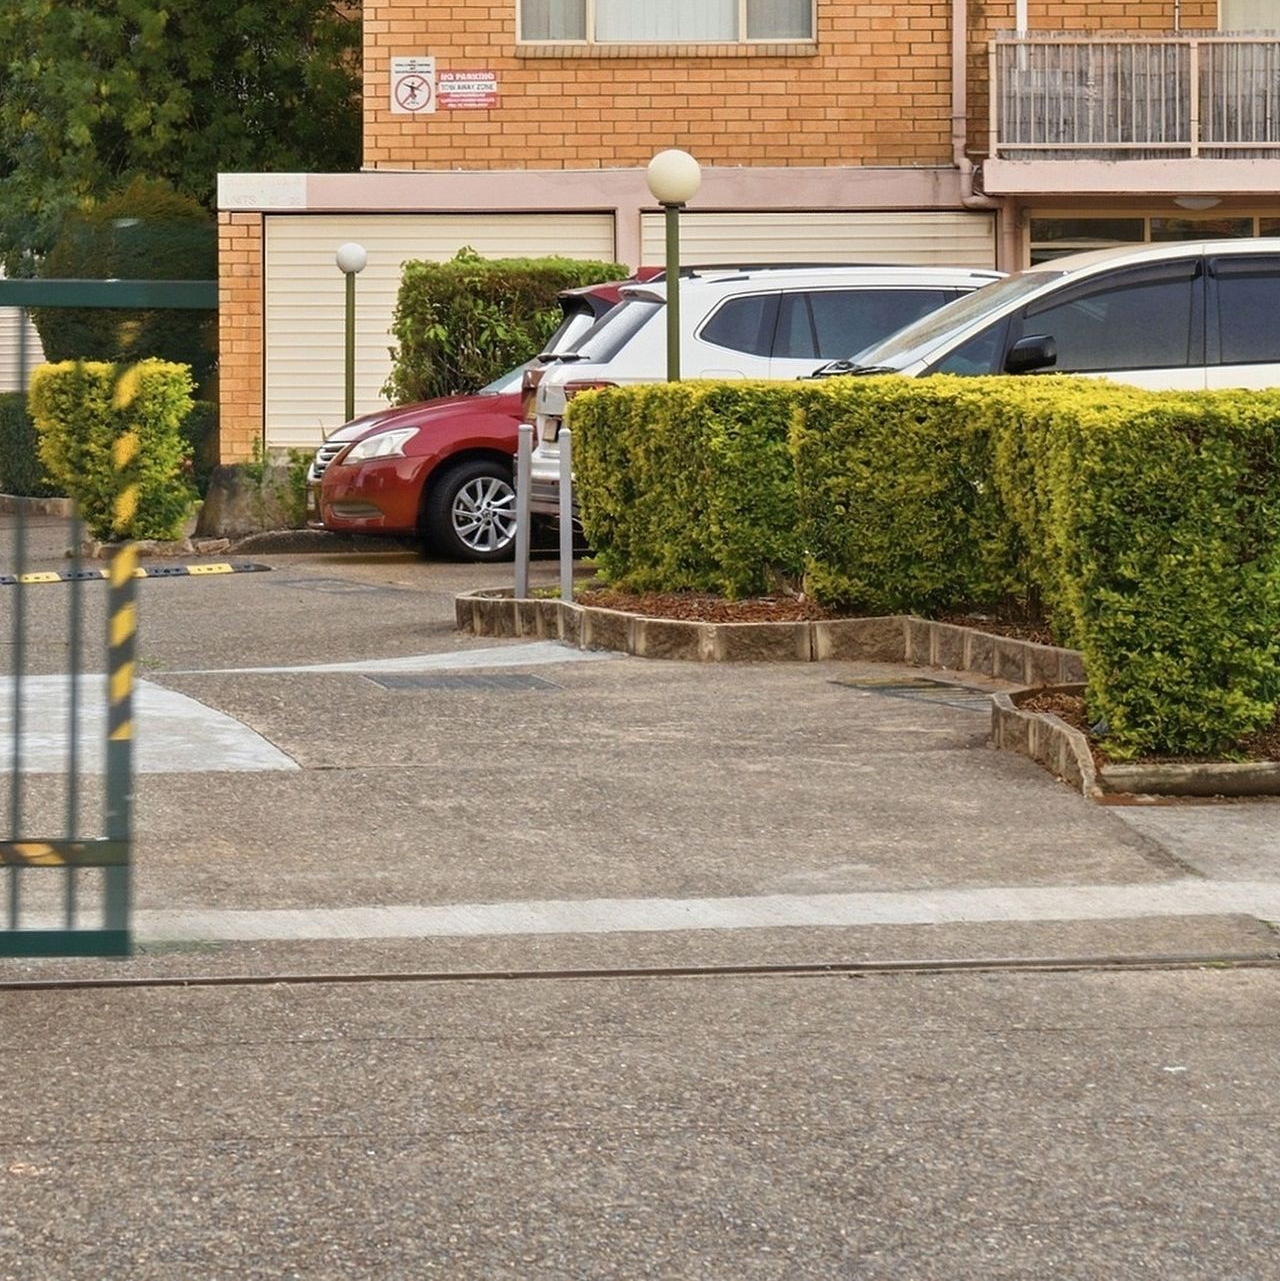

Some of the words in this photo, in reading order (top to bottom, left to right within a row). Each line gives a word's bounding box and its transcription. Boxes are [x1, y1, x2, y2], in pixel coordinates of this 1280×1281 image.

[440, 73, 454, 81] NO
[455, 73, 495, 81] PARKING
[441, 83, 456, 91] TOW
[457, 83, 475, 91] AWAY
[476, 83, 494, 91] ZONE
